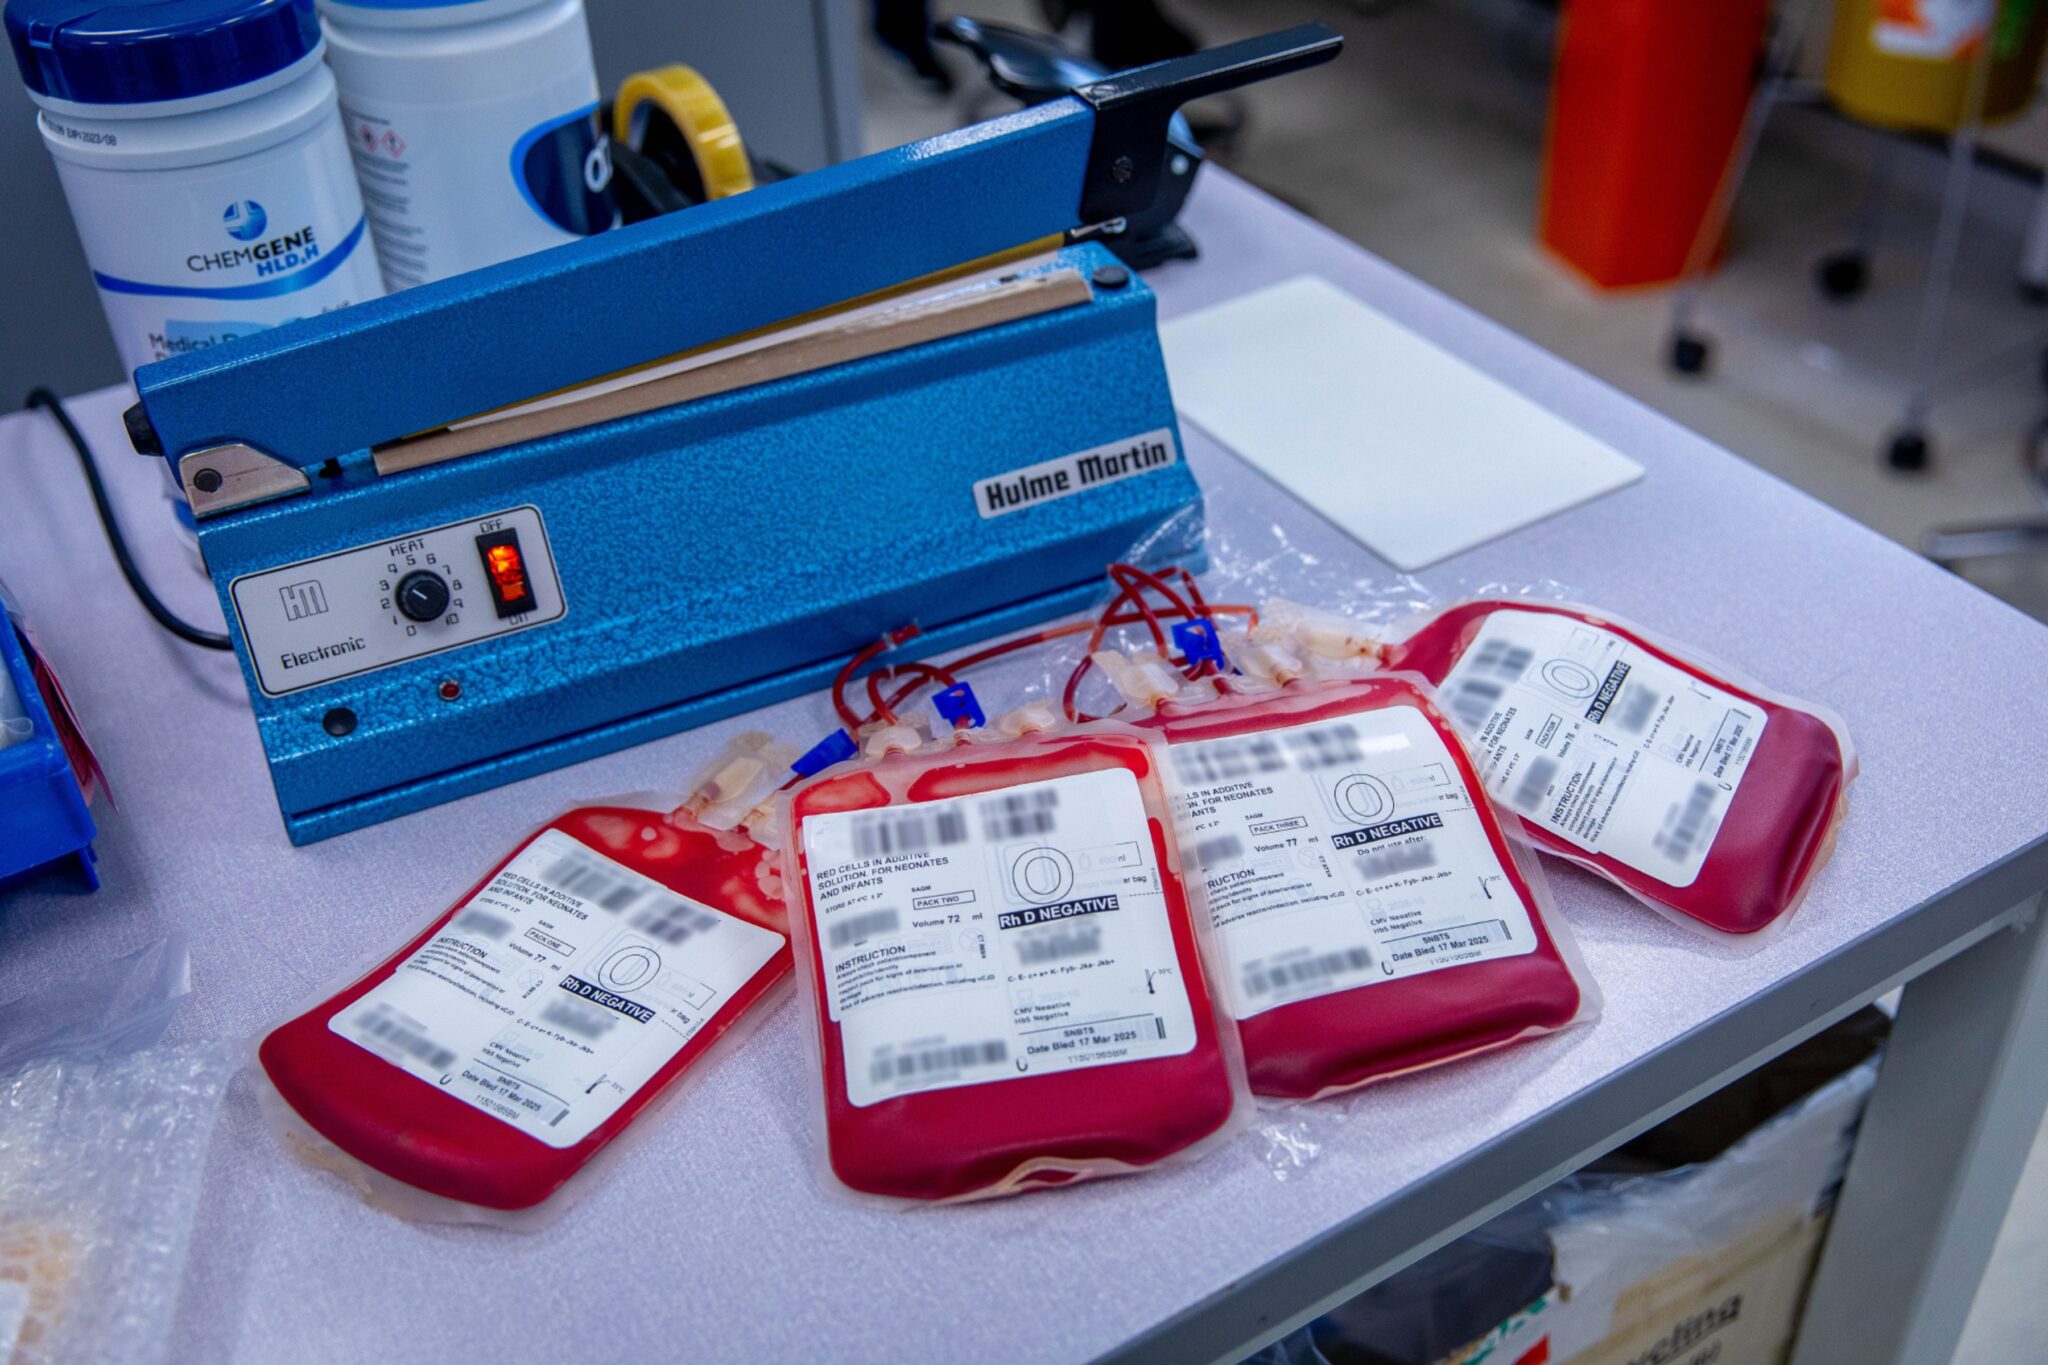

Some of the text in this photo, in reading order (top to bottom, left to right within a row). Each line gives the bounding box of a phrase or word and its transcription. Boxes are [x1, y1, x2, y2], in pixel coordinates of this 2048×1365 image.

[186, 226, 315, 272] CHEMGENE
[985, 442, 1168, 511] Hulme Martin
[480, 520, 503, 534] OFF
[389, 537, 425, 556] HEAT
[405, 554, 416, 566] 5
[426, 552, 437, 565] 6
[387, 563, 398, 574] 4
[443, 564, 452, 575] 7
[379, 579, 390, 591] 3
[452, 579, 463, 590] 8
[380, 598, 391, 609] 2
[453, 598, 464, 609] 9
[392, 614, 398, 625] 1
[445, 613, 460, 625] 10
[406, 625, 417, 637] 0
[281, 636, 366, 670] Electronic
[1541, 658, 1600, 699] O
[1598, 661, 1630, 704] NEGATIVE
[1593, 700, 1607, 710] D
[1483, 711, 1503, 736] ADDITIVE
[1587, 707, 1603, 723] Rh
[1488, 706, 1518, 748] FOR NEONATES
[1540, 721, 1557, 746] PACK FOUR
[1557, 741, 1571, 758] Volume
[1201, 781, 1254, 797] IN ADDITIVE
[1203, 796, 1223, 806] FOR
[1224, 786, 1274, 802] NEONATES
[1550, 771, 1583, 824] INSTRUCTION
[1334, 773, 1395, 826] O
[1253, 820, 1299, 833] PACK THREE
[1333, 814, 1442, 849] Rh D NEGATIVE
[1254, 843, 1285, 852] Volume
[1285, 838, 1297, 847] 77
[1357, 843, 1386, 856] Do not
[816, 852, 930, 881] RED CELLS IN ADDITIVE
[871, 865, 892, 876] FOR
[894, 856, 949, 872] NEONATES
[1012, 847, 1074, 905] O
[1132, 874, 1147, 883] bag
[1207, 868, 1256, 889] RUCTION
[1403, 878, 1420, 886] Fyb-
[503, 871, 517, 880] RED
[516, 876, 541, 889] CELLS
[548, 889, 585, 909] ADDITIVE
[820, 876, 884, 901] AND INFANTS
[911, 885, 931, 893] SAGM
[1217, 883, 1305, 911] pack signs deterioration
[502, 889, 535, 906] INFANTS
[531, 890, 589, 921] FOR NEONATES
[917, 895, 960, 907] PACK TWO
[825, 899, 857, 914] STORE AT
[1000, 897, 1119, 928] Rh D NEGATIVE
[912, 912, 983, 928] Volume 72 ml
[1221, 914, 1245, 926] adverse
[1370, 909, 1423, 926] CMV Negative
[1373, 918, 1423, 935] HbS Negative
[529, 931, 561, 950] PACK ONE
[1422, 932, 1450, 944] SNBTS
[509, 942, 547, 963] Volume 77
[1392, 935, 1489, 962] Date Bled 17 Mar 2025
[835, 945, 906, 973] INSTRUCTION
[857, 961, 875, 972] check
[1060, 966, 1078, 974] Fyb-
[1097, 959, 1115, 967] Jkb+
[597, 945, 662, 994] O
[860, 964, 955, 988] pack for signs deterioration
[861, 992, 885, 1005] adverse
[977, 974, 995, 982] vCJD
[561, 976, 656, 1025] Rh D NEGATIVE
[1013, 1001, 1071, 1016] CMV Negative
[1014, 1010, 1069, 1025] HbS Negative
[1064, 1027, 1095, 1037] SNBTS
[1027, 1031, 1137, 1055] Date Bled 17 Mar 2025
[461, 1070, 542, 1113] Date Bled 17 Mar 2025
